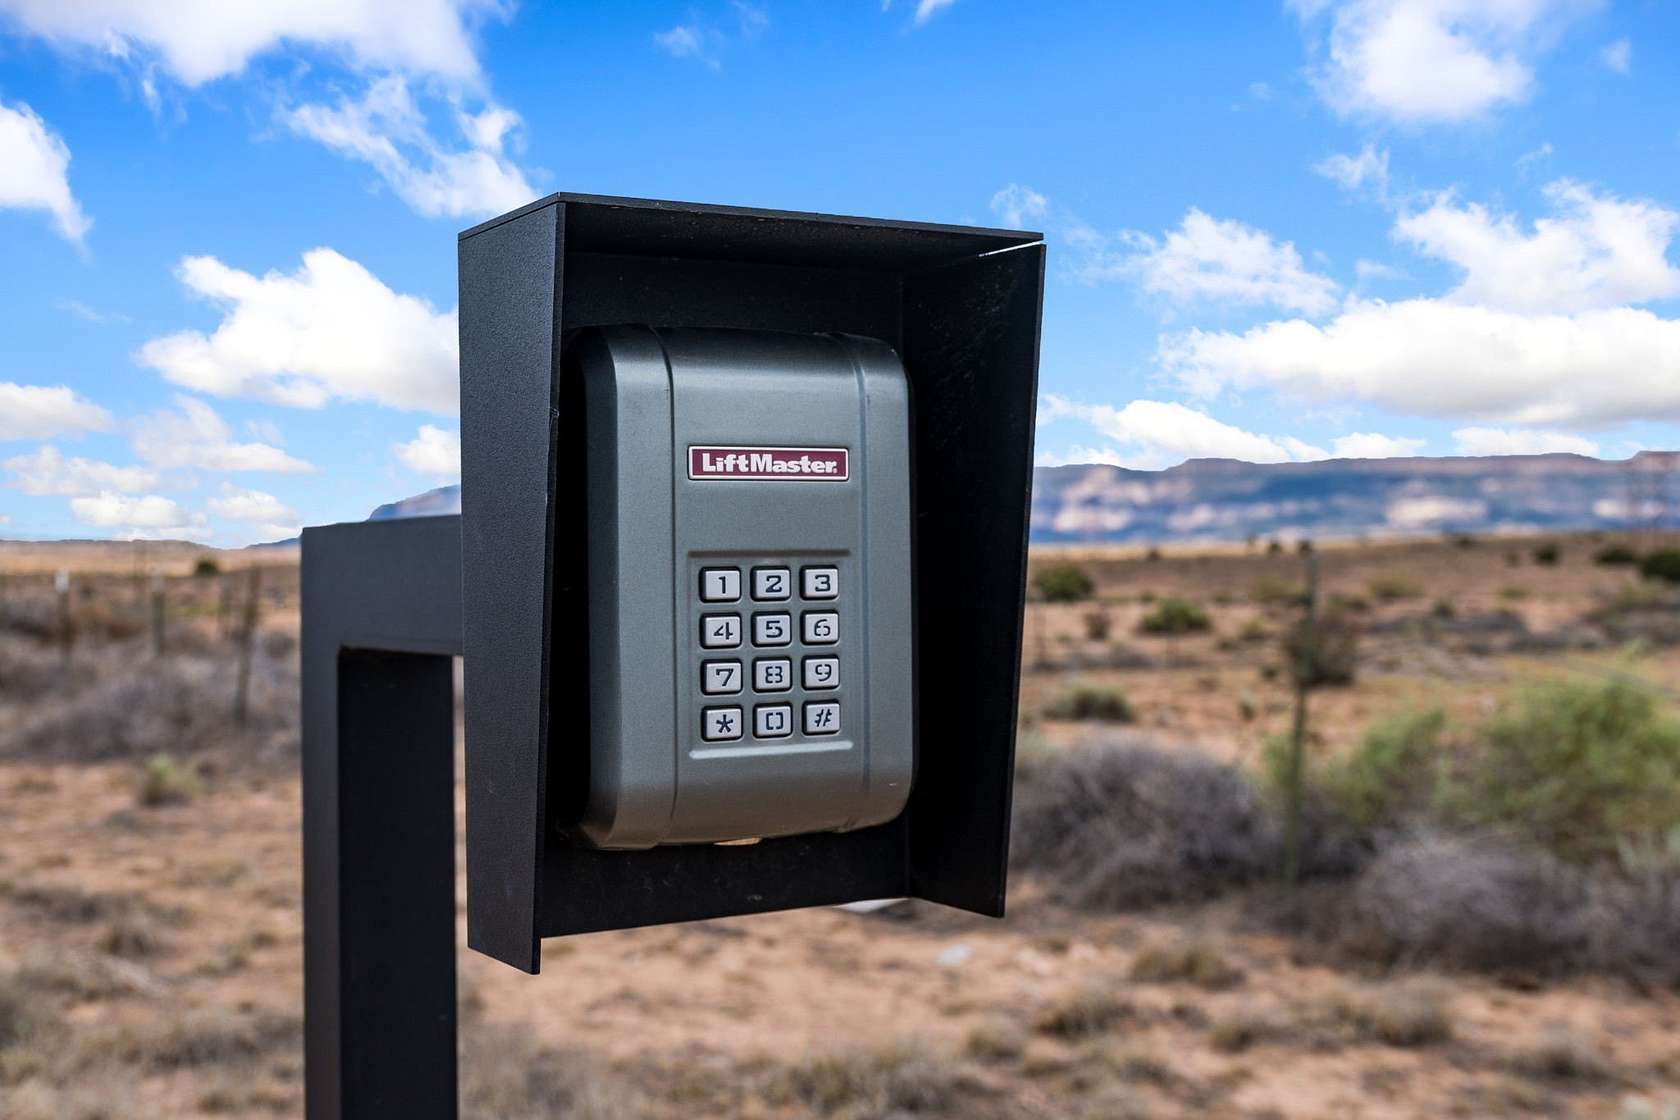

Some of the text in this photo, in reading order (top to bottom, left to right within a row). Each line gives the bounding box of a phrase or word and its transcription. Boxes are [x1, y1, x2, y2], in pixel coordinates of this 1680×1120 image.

[702, 453, 837, 474] LiftMaster
[718, 574, 831, 594] 1 2 3
[713, 618, 831, 640] 4 5 6
[715, 664, 832, 687] 7 8 9
[765, 711, 784, 731] 0
[814, 708, 832, 728] #
